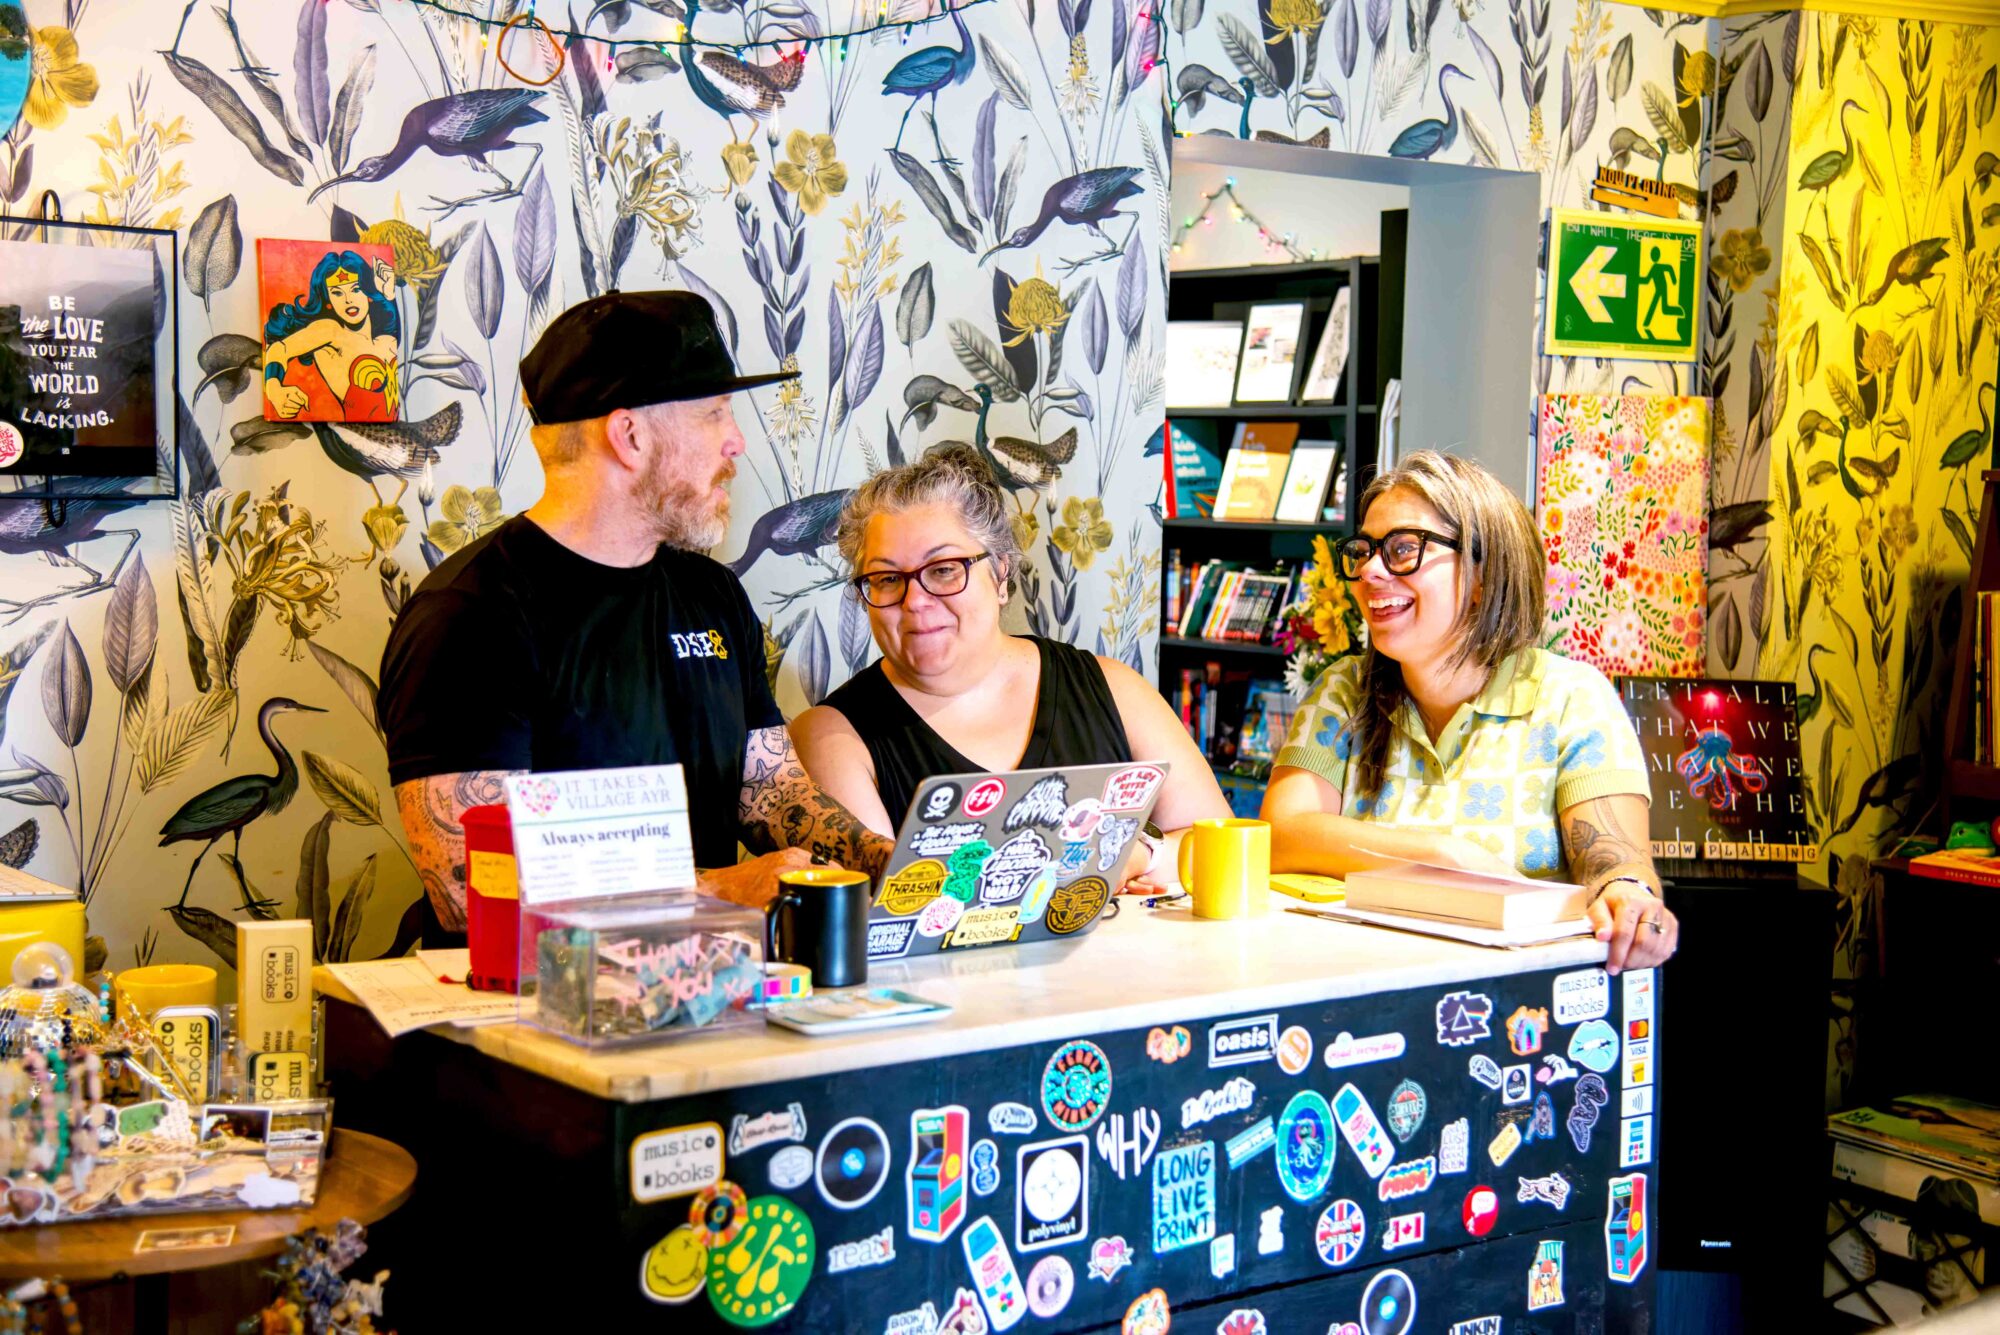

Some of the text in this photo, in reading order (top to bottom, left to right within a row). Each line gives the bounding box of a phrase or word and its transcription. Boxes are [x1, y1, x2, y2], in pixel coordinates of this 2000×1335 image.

[1599, 167, 1677, 199] NOW PLAYING
[49, 296, 75, 311] BE
[22, 316, 104, 343] the LOVE
[29, 344, 97, 359] YOU FEAR
[54, 361, 74, 371] THE
[29, 374, 99, 395] WORLD
[56, 398, 71, 409] is
[20, 407, 115, 429] LACKING.
[1176, 466, 1206, 477] about
[1629, 681, 1796, 705] LET ALL
[1631, 716, 1798, 741] THAT WE
[565, 774, 666, 794] IT TAKES A
[566, 788, 671, 811] VILLAGE AYR
[1725, 792, 1804, 813] THE
[540, 822, 671, 847] Always accepting
[1652, 844, 1816, 858] NOW PLAYING
[985, 884, 1021, 898] WAR
[991, 875, 1023, 887] NOT
[965, 910, 1008, 924] music
[967, 925, 1010, 941] books
[266, 960, 278, 998] books
[284, 952, 294, 992] music
[1559, 976, 1596, 994] music
[1567, 1000, 1605, 1017] books
[1216, 1026, 1269, 1052] oasis
[644, 1135, 703, 1161] music
[1096, 1107, 1161, 1180] WHY
[655, 1164, 715, 1189] books
[1158, 1148, 1210, 1187] LONG
[1158, 1180, 1208, 1220] LIVE
[1028, 1217, 1076, 1241] polyvinyl
[1157, 1212, 1210, 1247] PRINT
